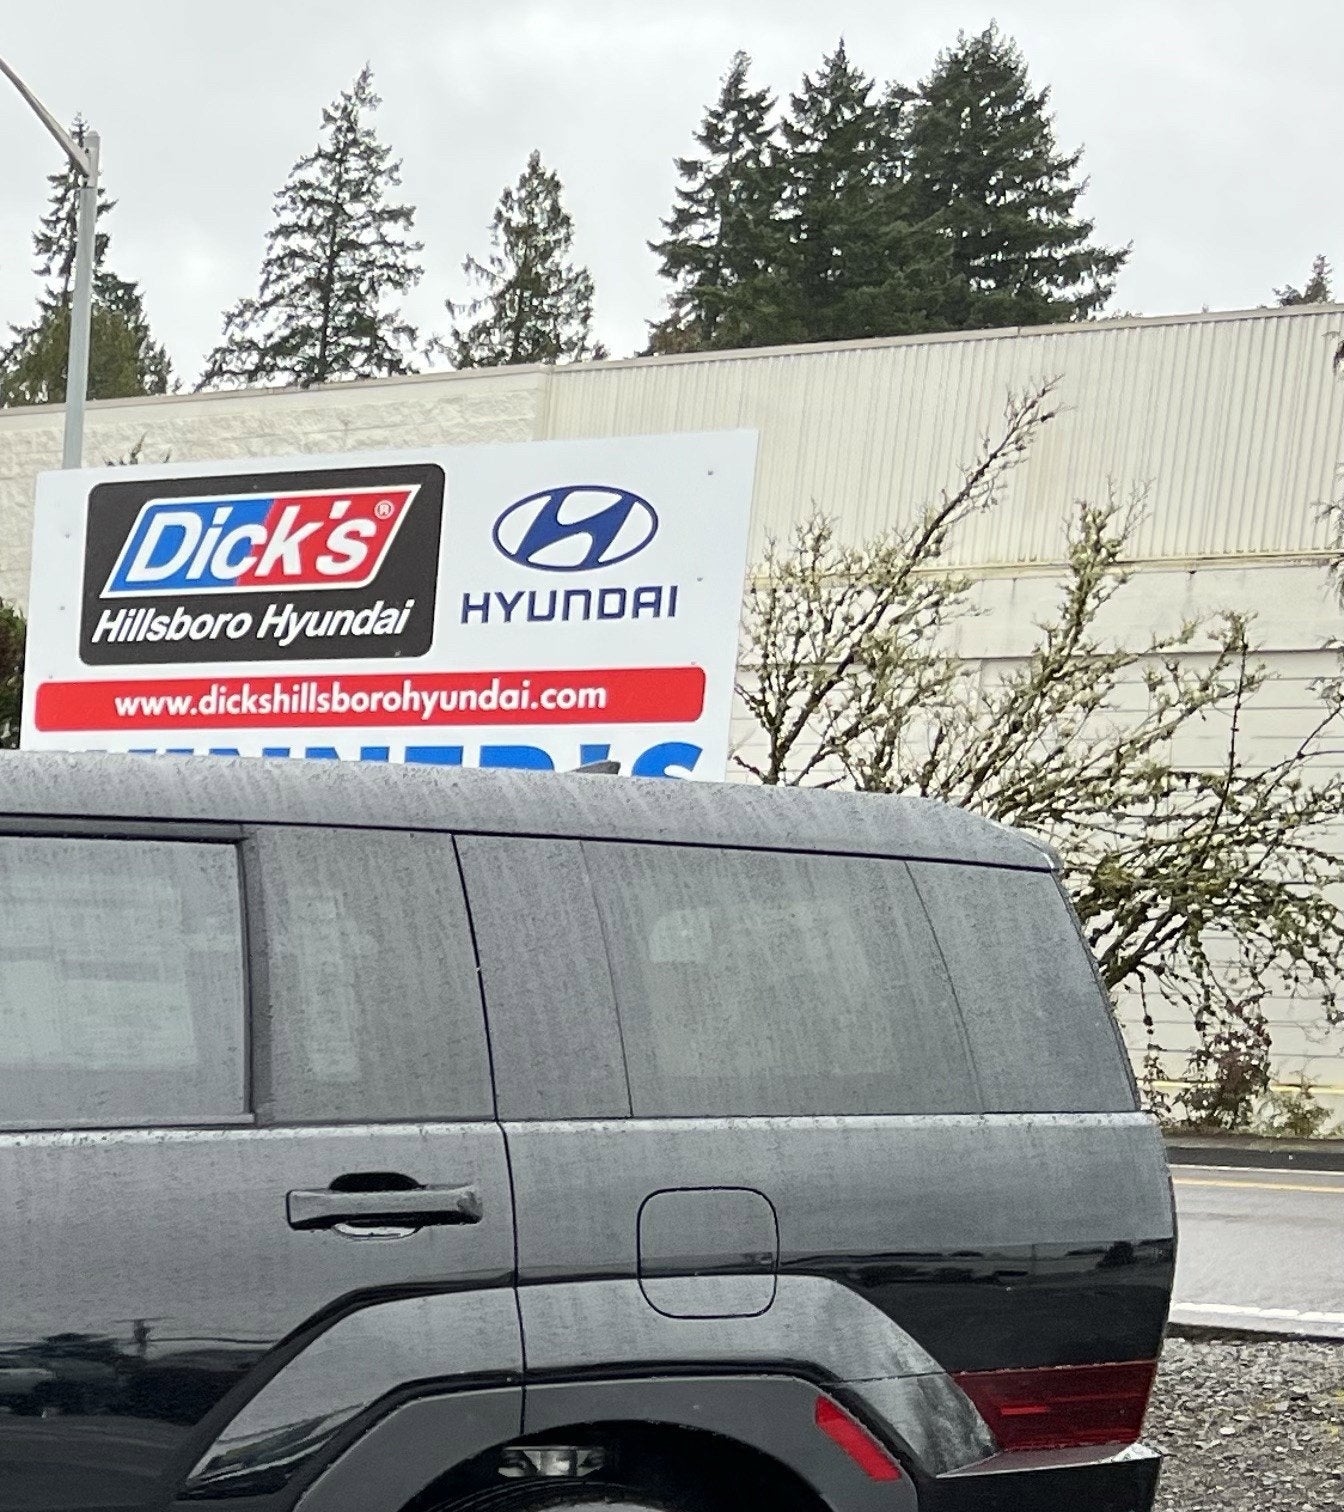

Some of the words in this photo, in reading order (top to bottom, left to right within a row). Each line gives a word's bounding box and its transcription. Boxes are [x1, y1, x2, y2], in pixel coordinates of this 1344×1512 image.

[125, 500, 377, 581] Dick's
[91, 606, 253, 643] Hillsboro
[256, 599, 415, 647] Hyundai
[461, 585, 678, 624] HYUNDAI
[114, 678, 607, 718] www.dickshillsborohyundai.com
